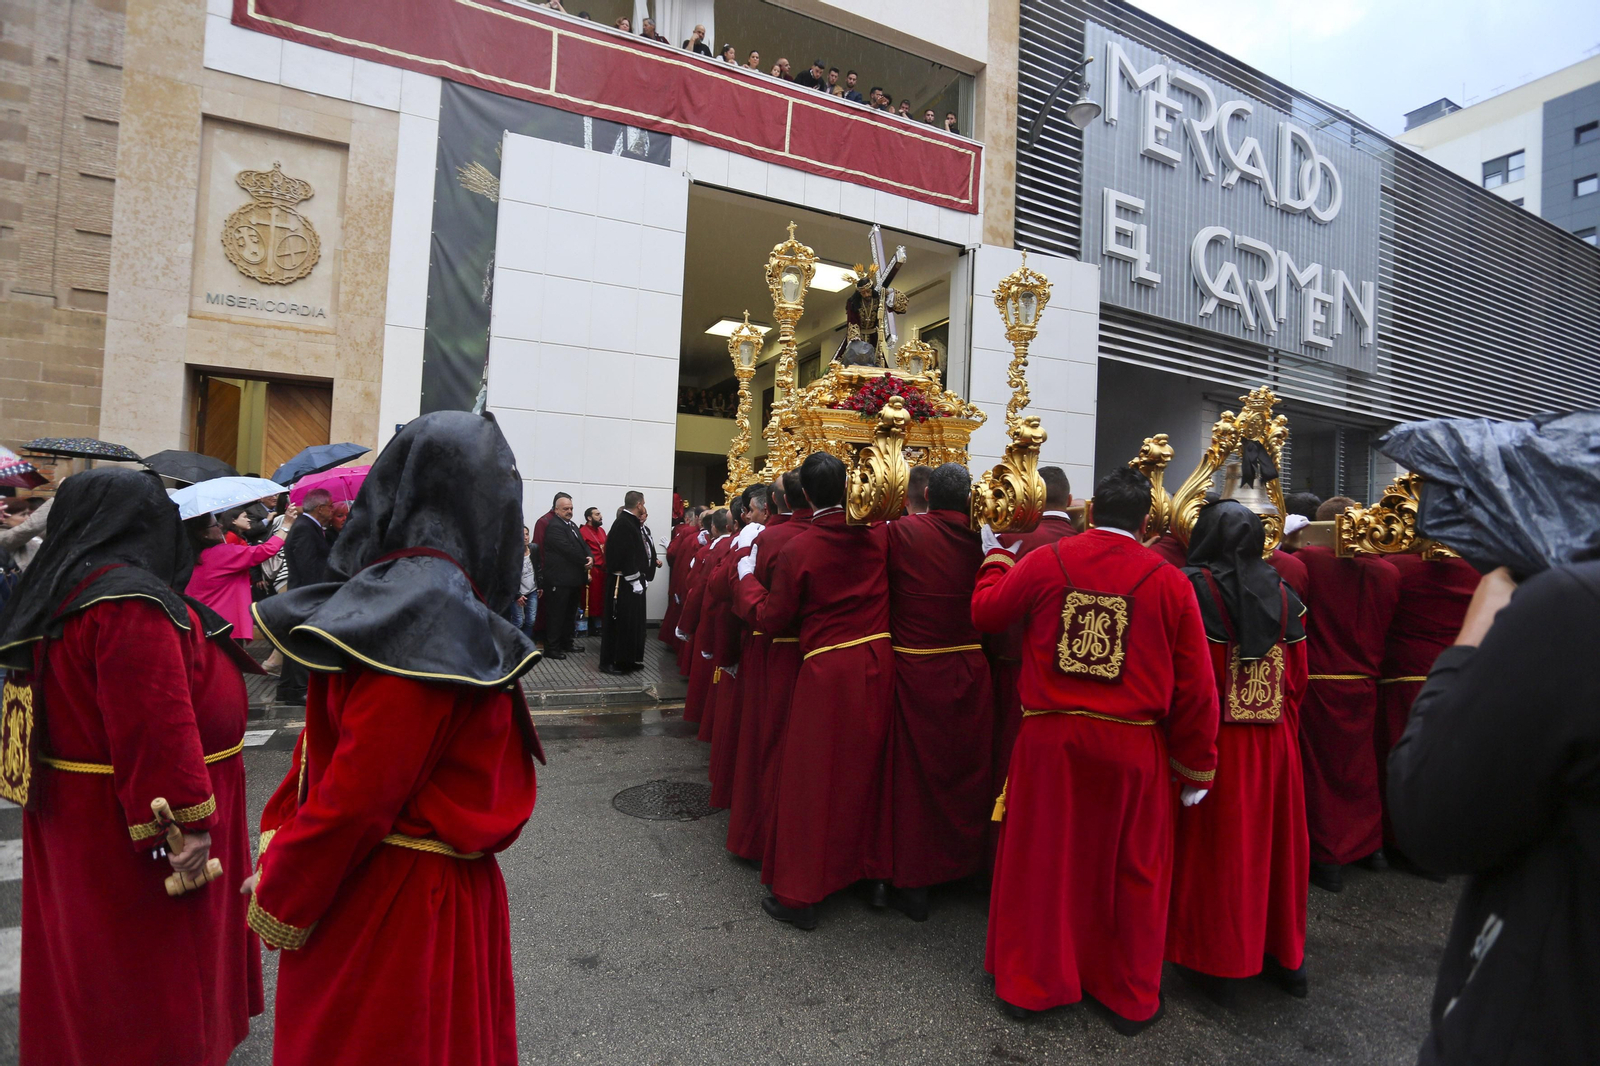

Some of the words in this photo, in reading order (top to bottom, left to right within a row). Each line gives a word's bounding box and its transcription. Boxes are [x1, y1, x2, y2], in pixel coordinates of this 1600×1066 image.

[1105, 42, 1342, 224] MERCADO
[206, 292, 326, 318] MISERICORDIA
[1103, 187, 1161, 287] EL
[1190, 226, 1374, 350] CARMEN
